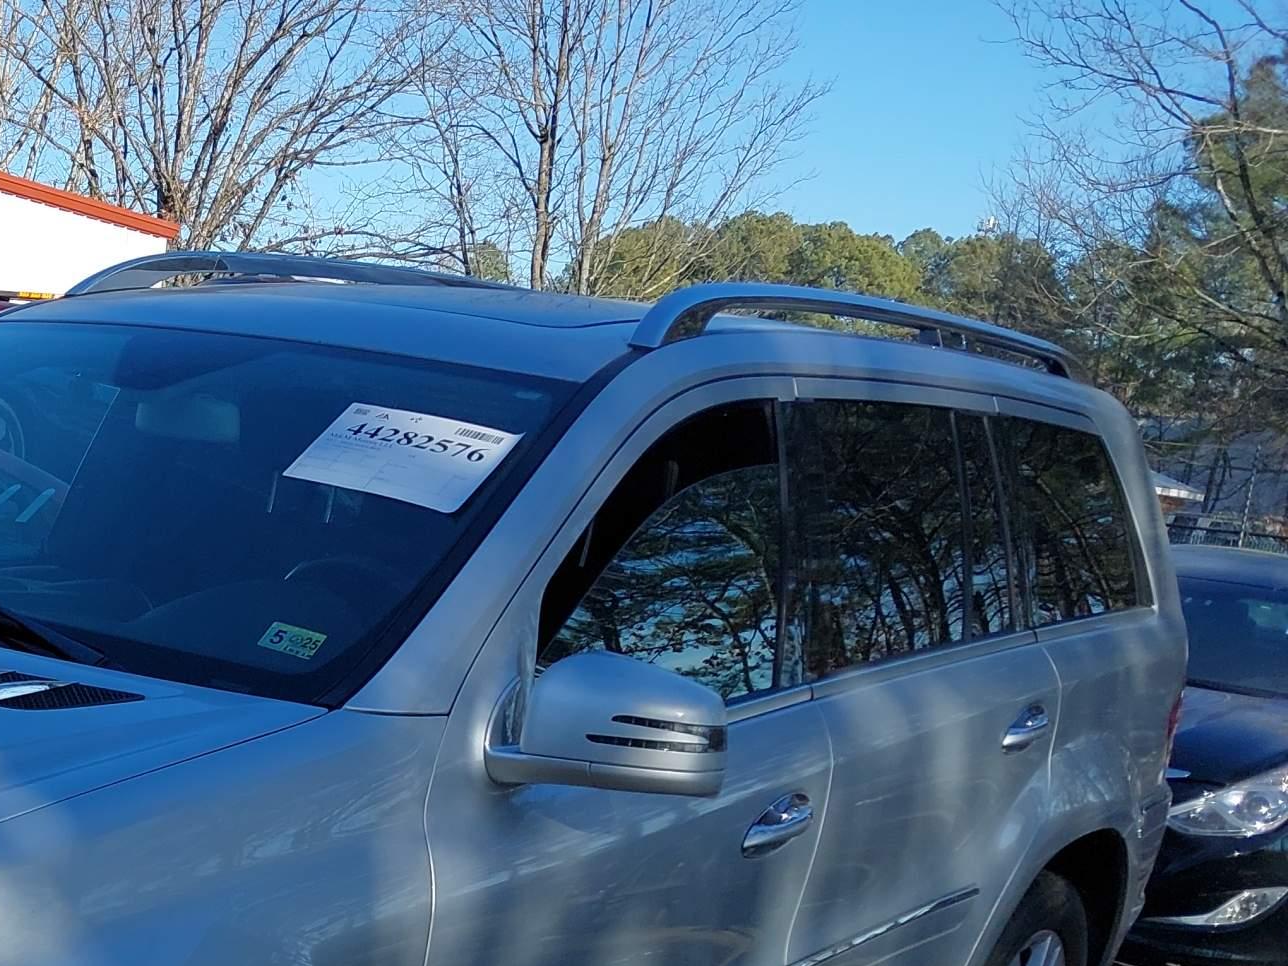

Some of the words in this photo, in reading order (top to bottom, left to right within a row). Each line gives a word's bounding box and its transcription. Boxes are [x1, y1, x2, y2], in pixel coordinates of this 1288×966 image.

[346, 422, 491, 463] 44282576
[270, 629, 287, 644] 5
[301, 637, 320, 650] 25
